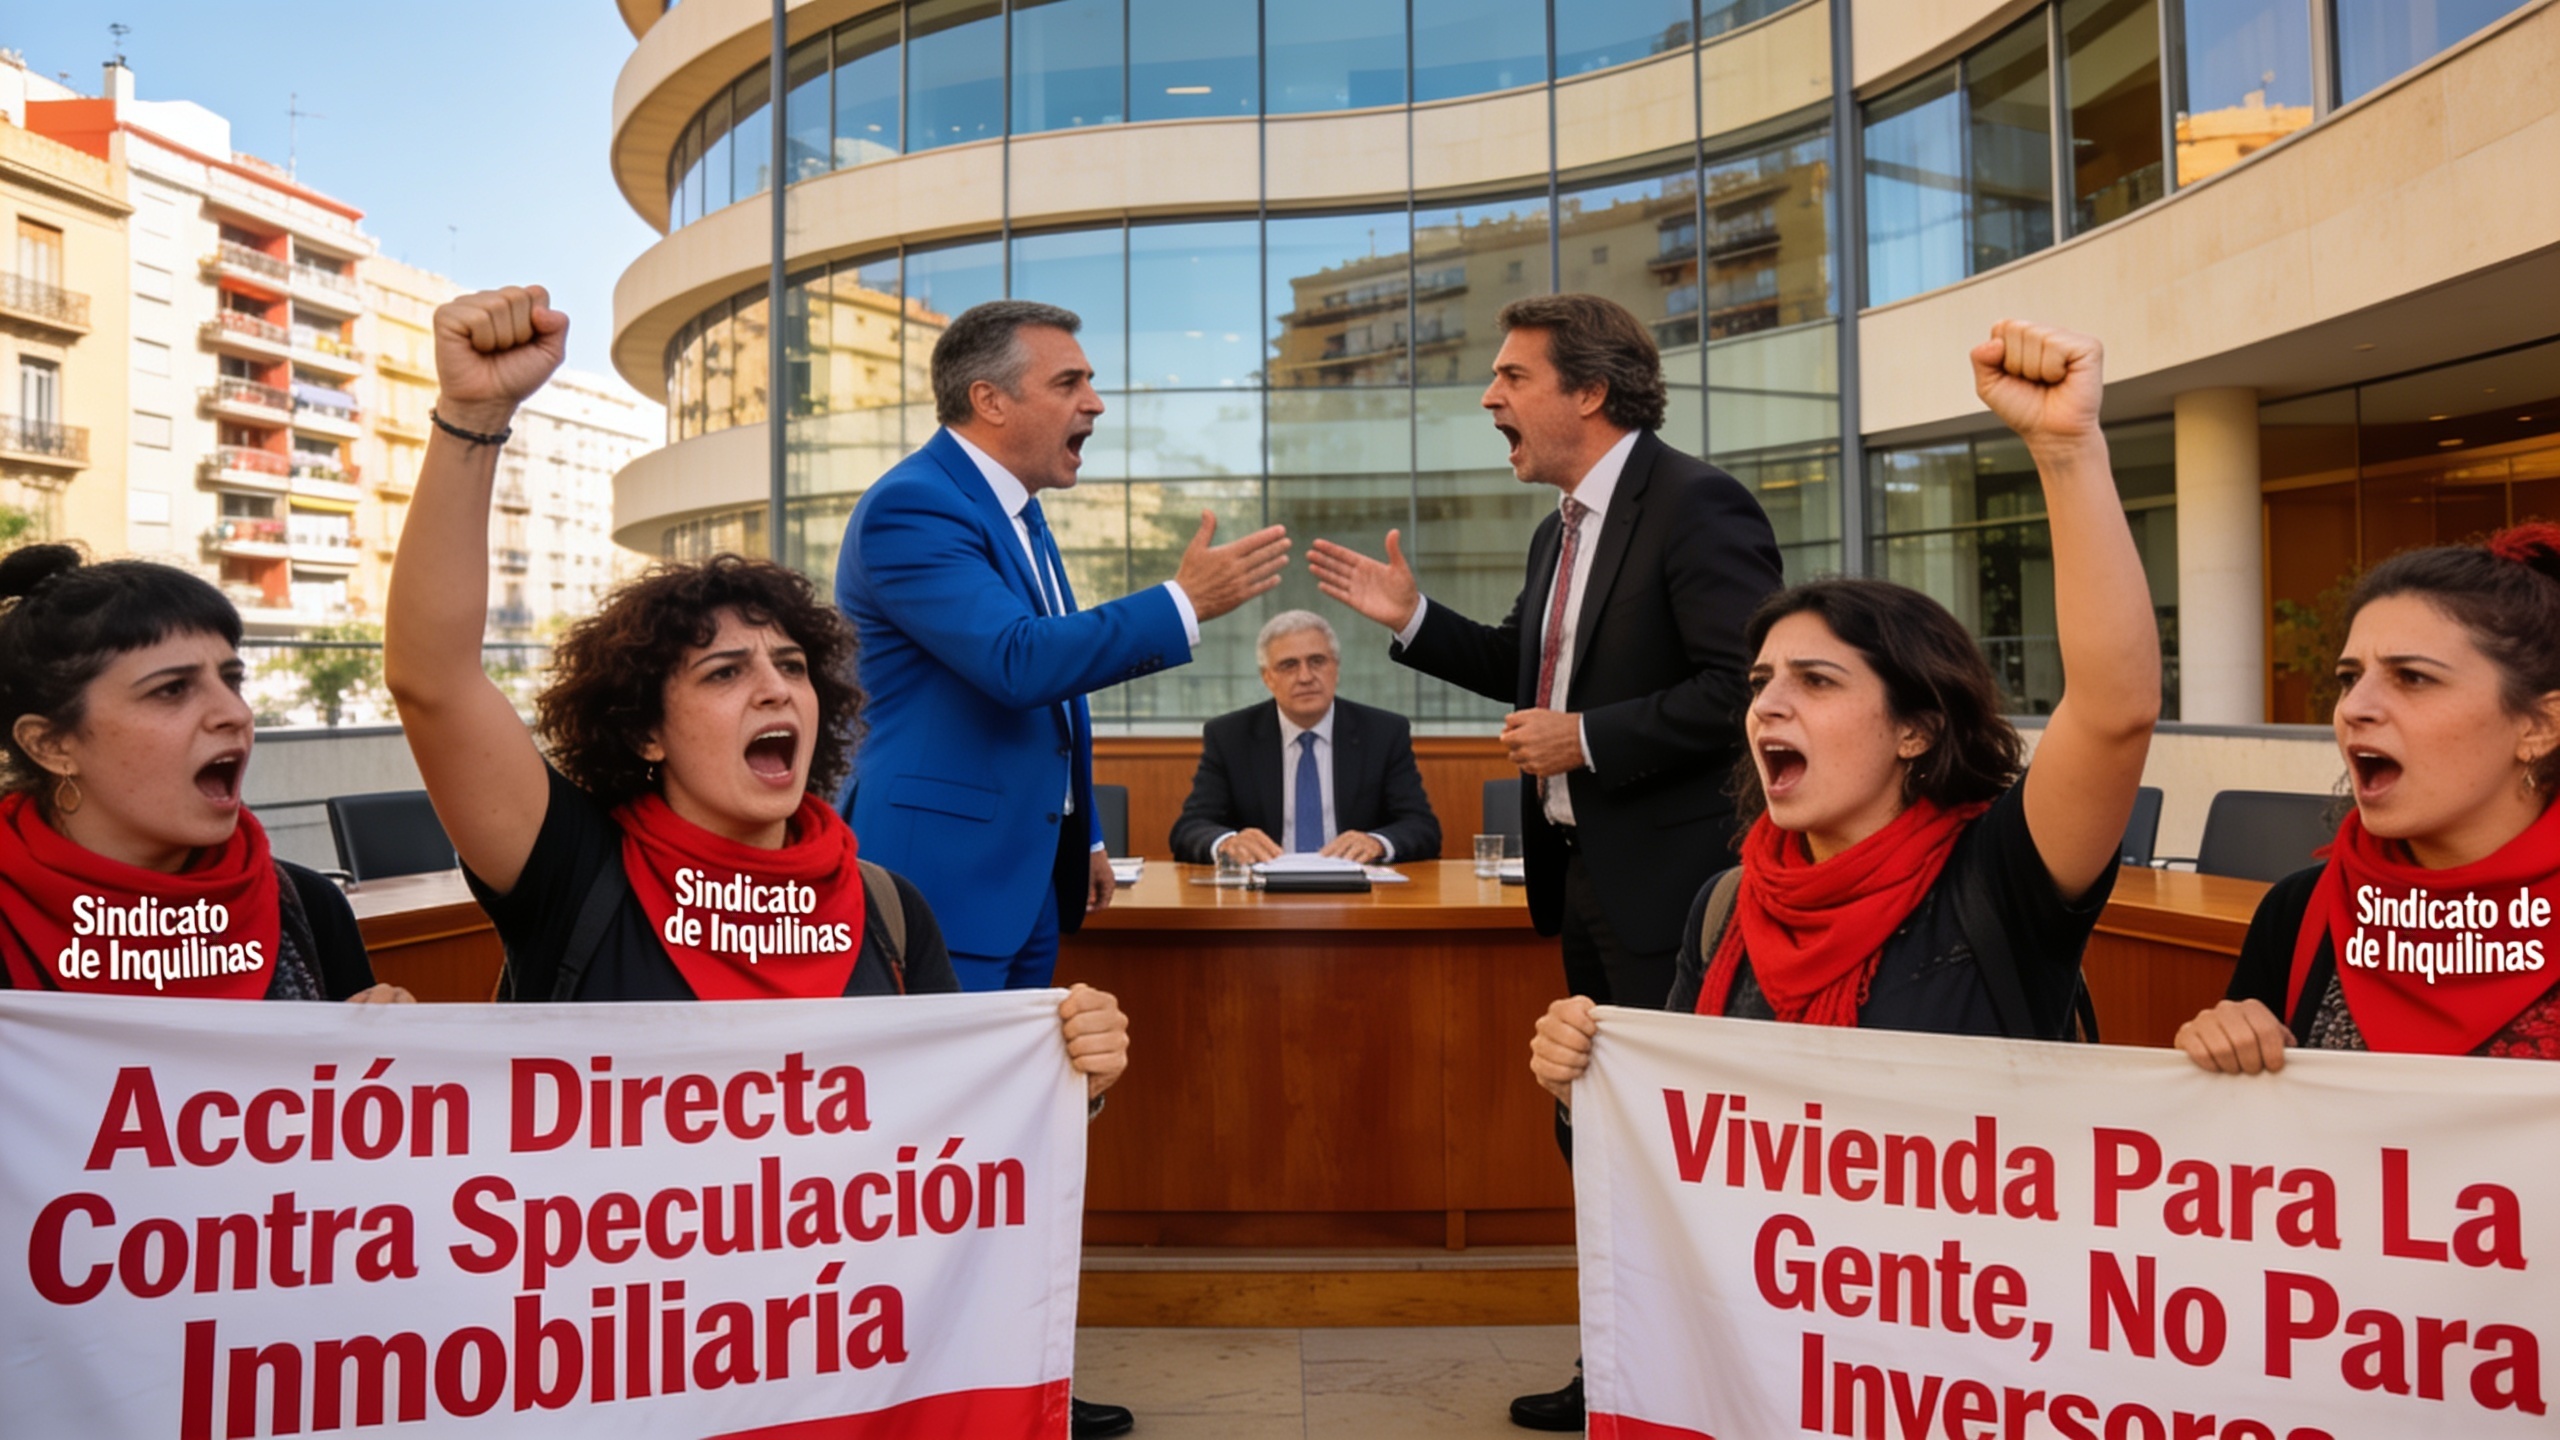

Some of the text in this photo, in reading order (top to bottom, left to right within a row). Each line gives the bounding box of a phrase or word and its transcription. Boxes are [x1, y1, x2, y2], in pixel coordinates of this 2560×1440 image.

[72, 894, 229, 937] Sindicato
[675, 867, 816, 914] Sindicato
[2356, 884, 2551, 930] Sindicato de
[58, 937, 264, 991] de Inquilinas
[664, 906, 852, 964] de Inquilinas
[2345, 926, 2545, 985] de Inquilinas
[84, 1052, 871, 1170] Acción Directa
[28, 1137, 1026, 1305] Contra Speculación
[1662, 1088, 2529, 1271] Vivienda Para La
[180, 1261, 909, 1440] Inmobiliaría
[1753, 1213, 2548, 1416] Gente, No Para
[1800, 1332, 2336, 1440] Invers
